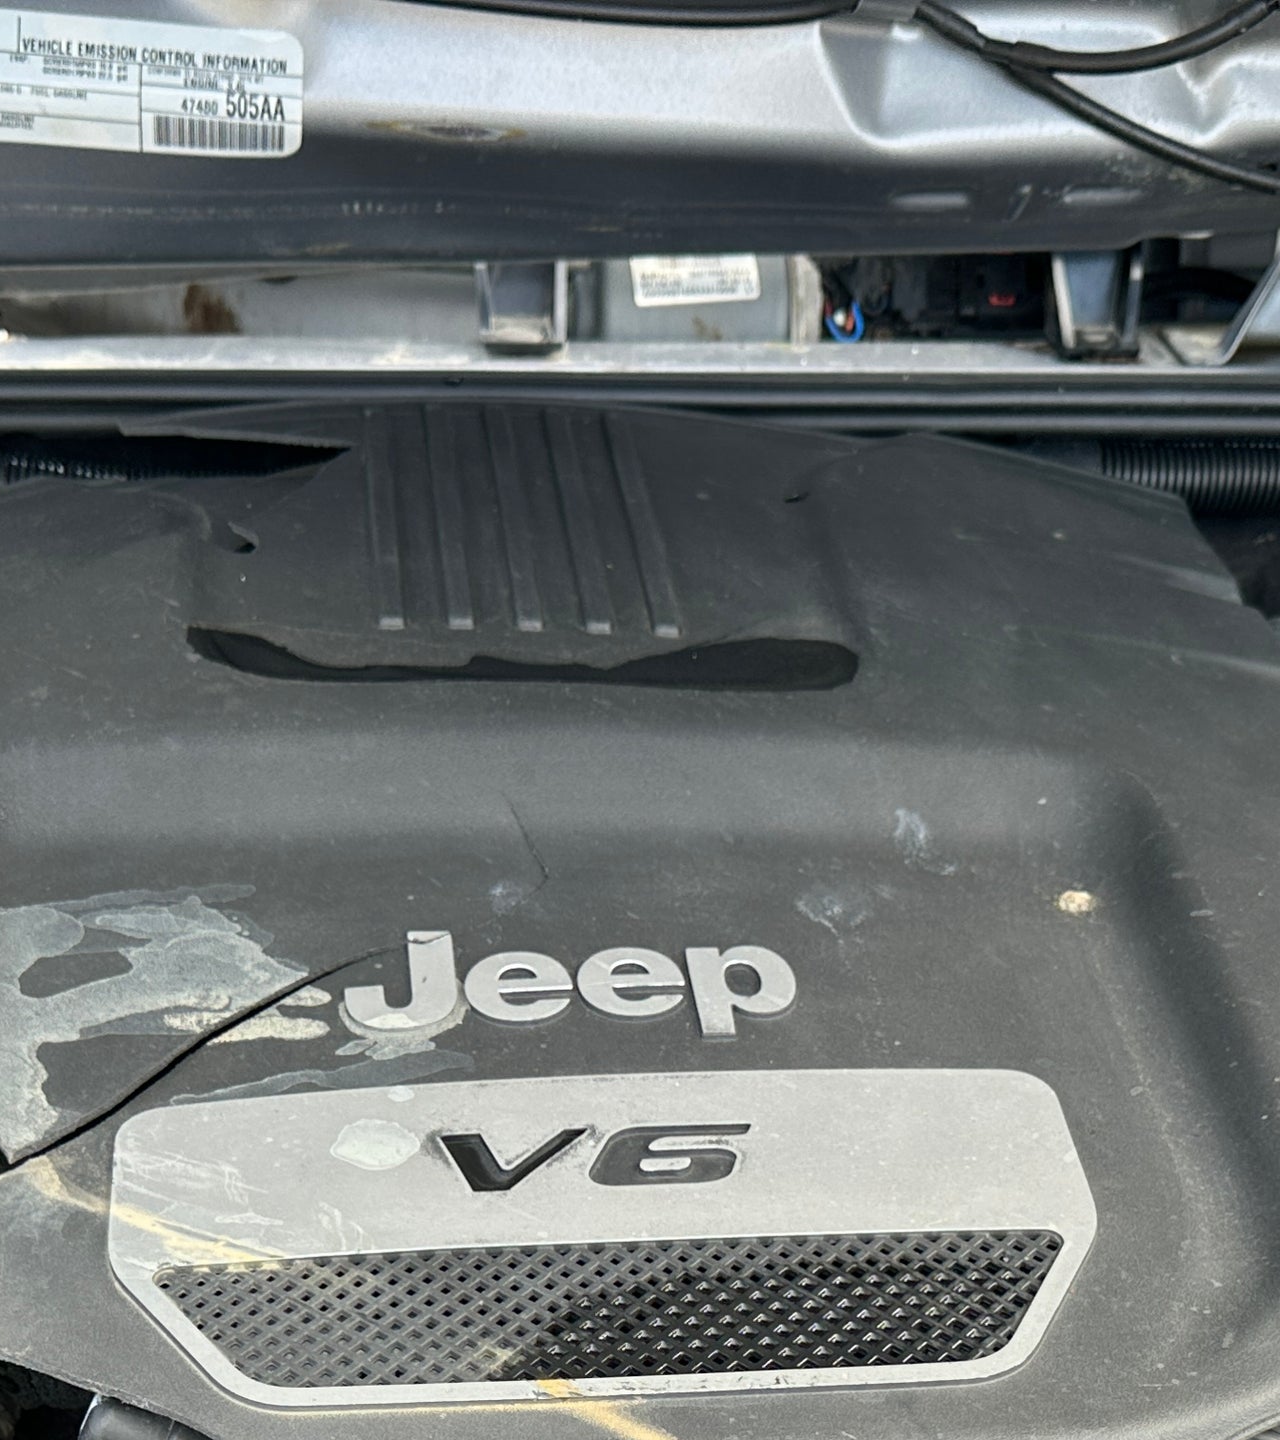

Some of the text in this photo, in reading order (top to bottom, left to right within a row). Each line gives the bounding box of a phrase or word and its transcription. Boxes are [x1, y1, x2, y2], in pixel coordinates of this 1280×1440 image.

[22, 38, 73, 56] VEHICLE
[78, 43, 138, 62] EMISSION
[141, 48, 197, 68] CONTROL
[203, 54, 288, 74] INFORMATION
[226, 92, 286, 122] 505AA
[344, 930, 797, 1038] Jeep
[439, 1123, 751, 1192] V6
